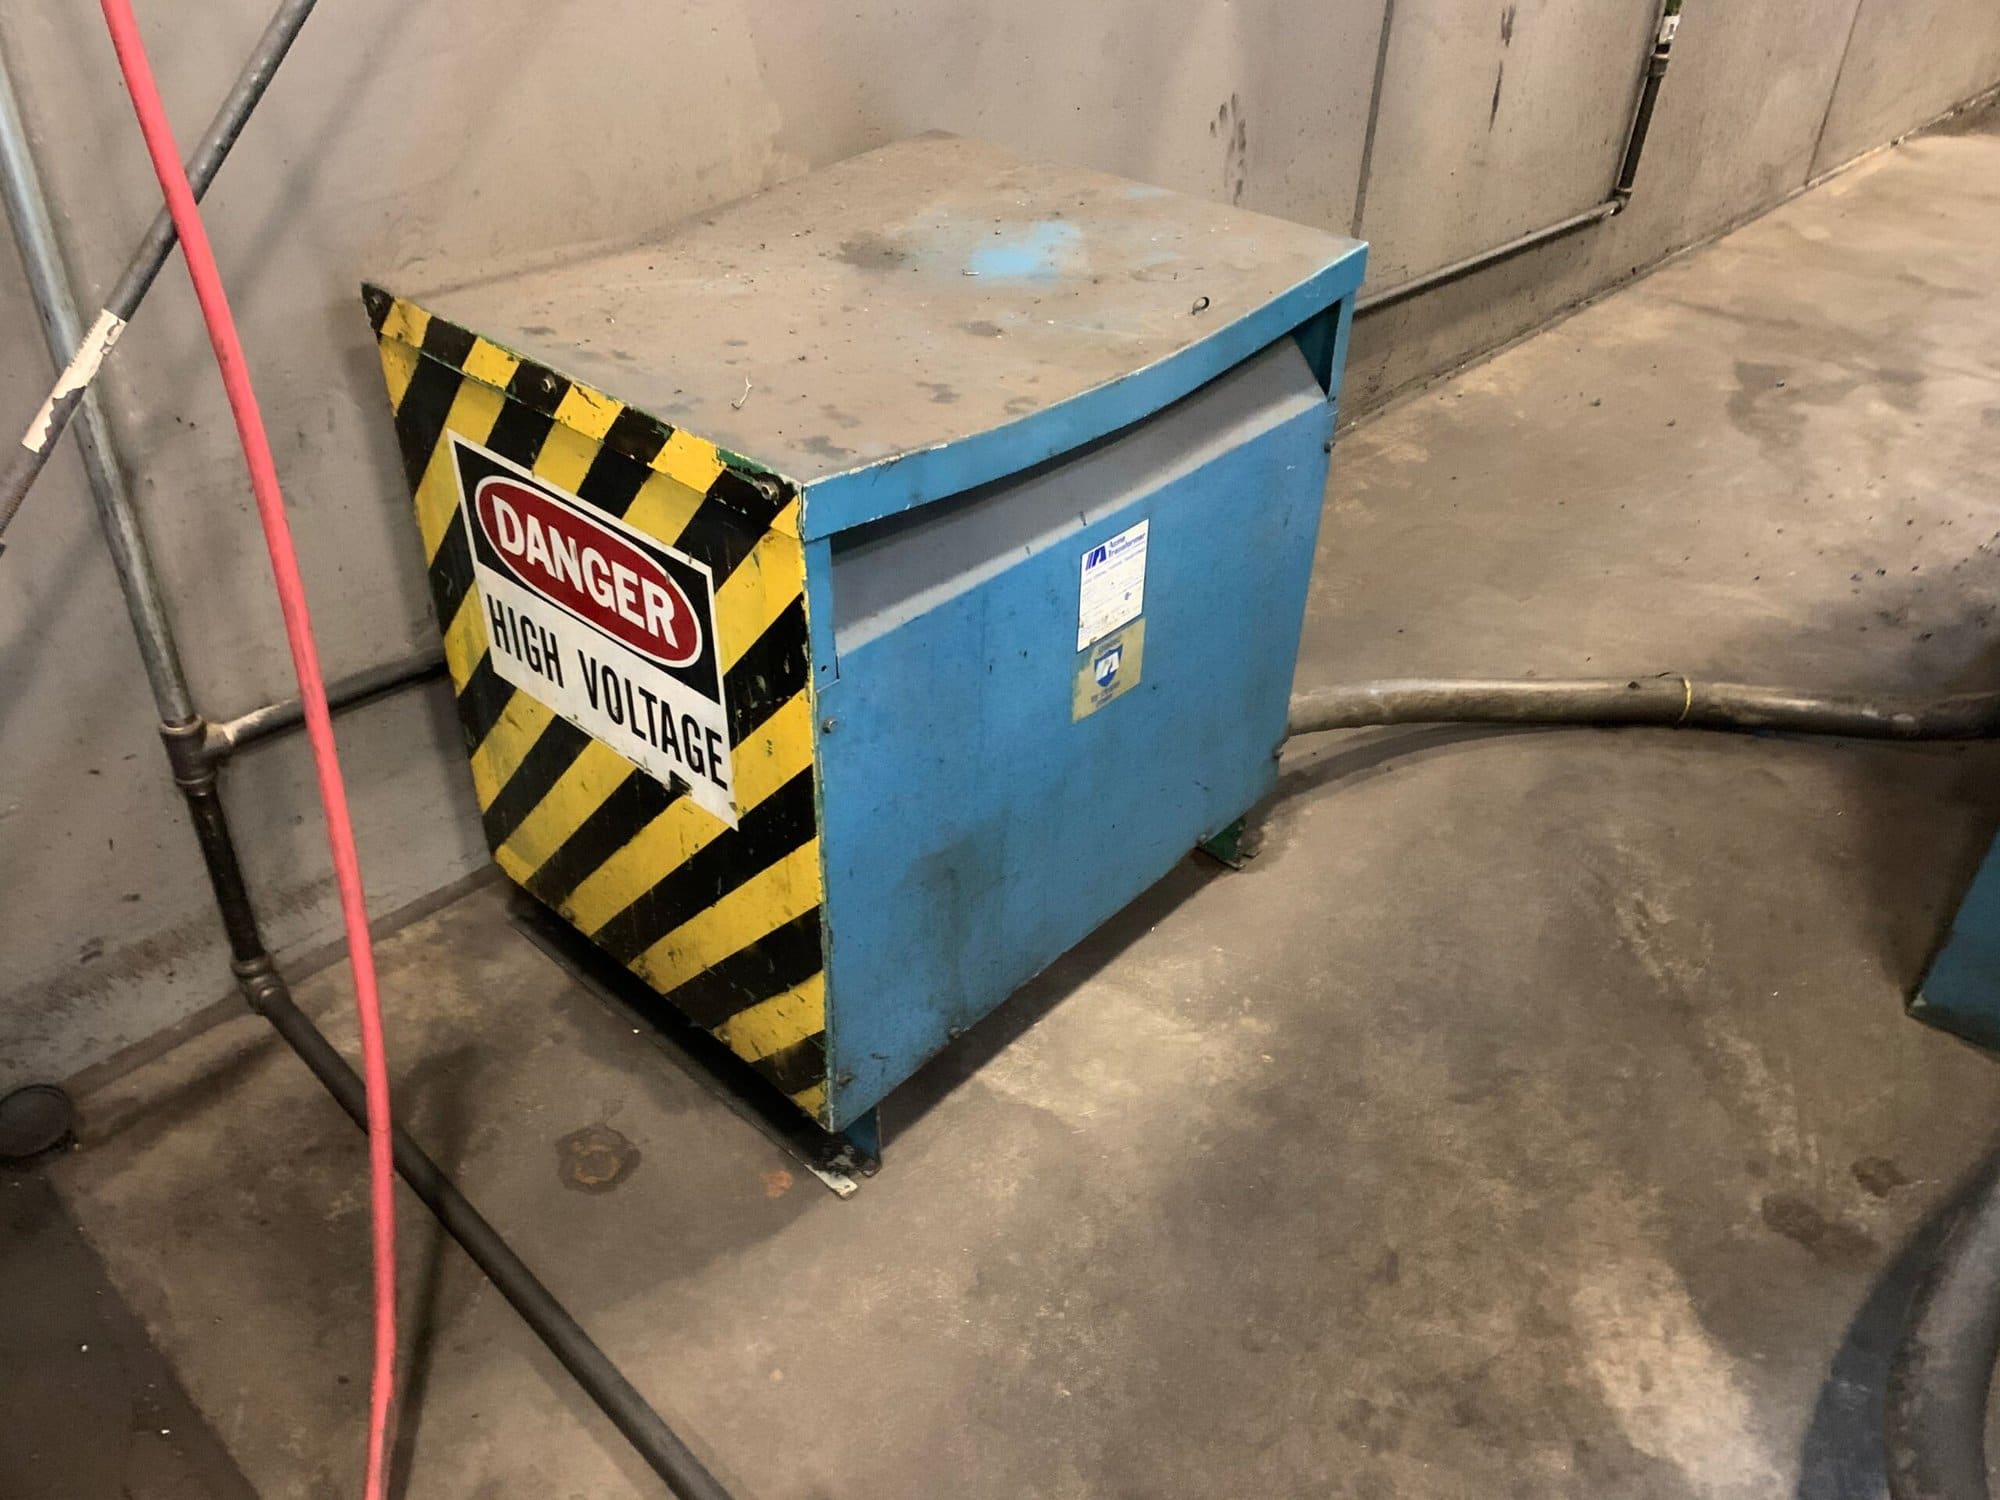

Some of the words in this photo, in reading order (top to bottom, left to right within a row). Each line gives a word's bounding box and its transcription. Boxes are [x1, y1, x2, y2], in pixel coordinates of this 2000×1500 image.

[491, 493, 679, 650] DANGER
[486, 593, 565, 689] HIGH
[578, 648, 729, 792] VOLTAGE
